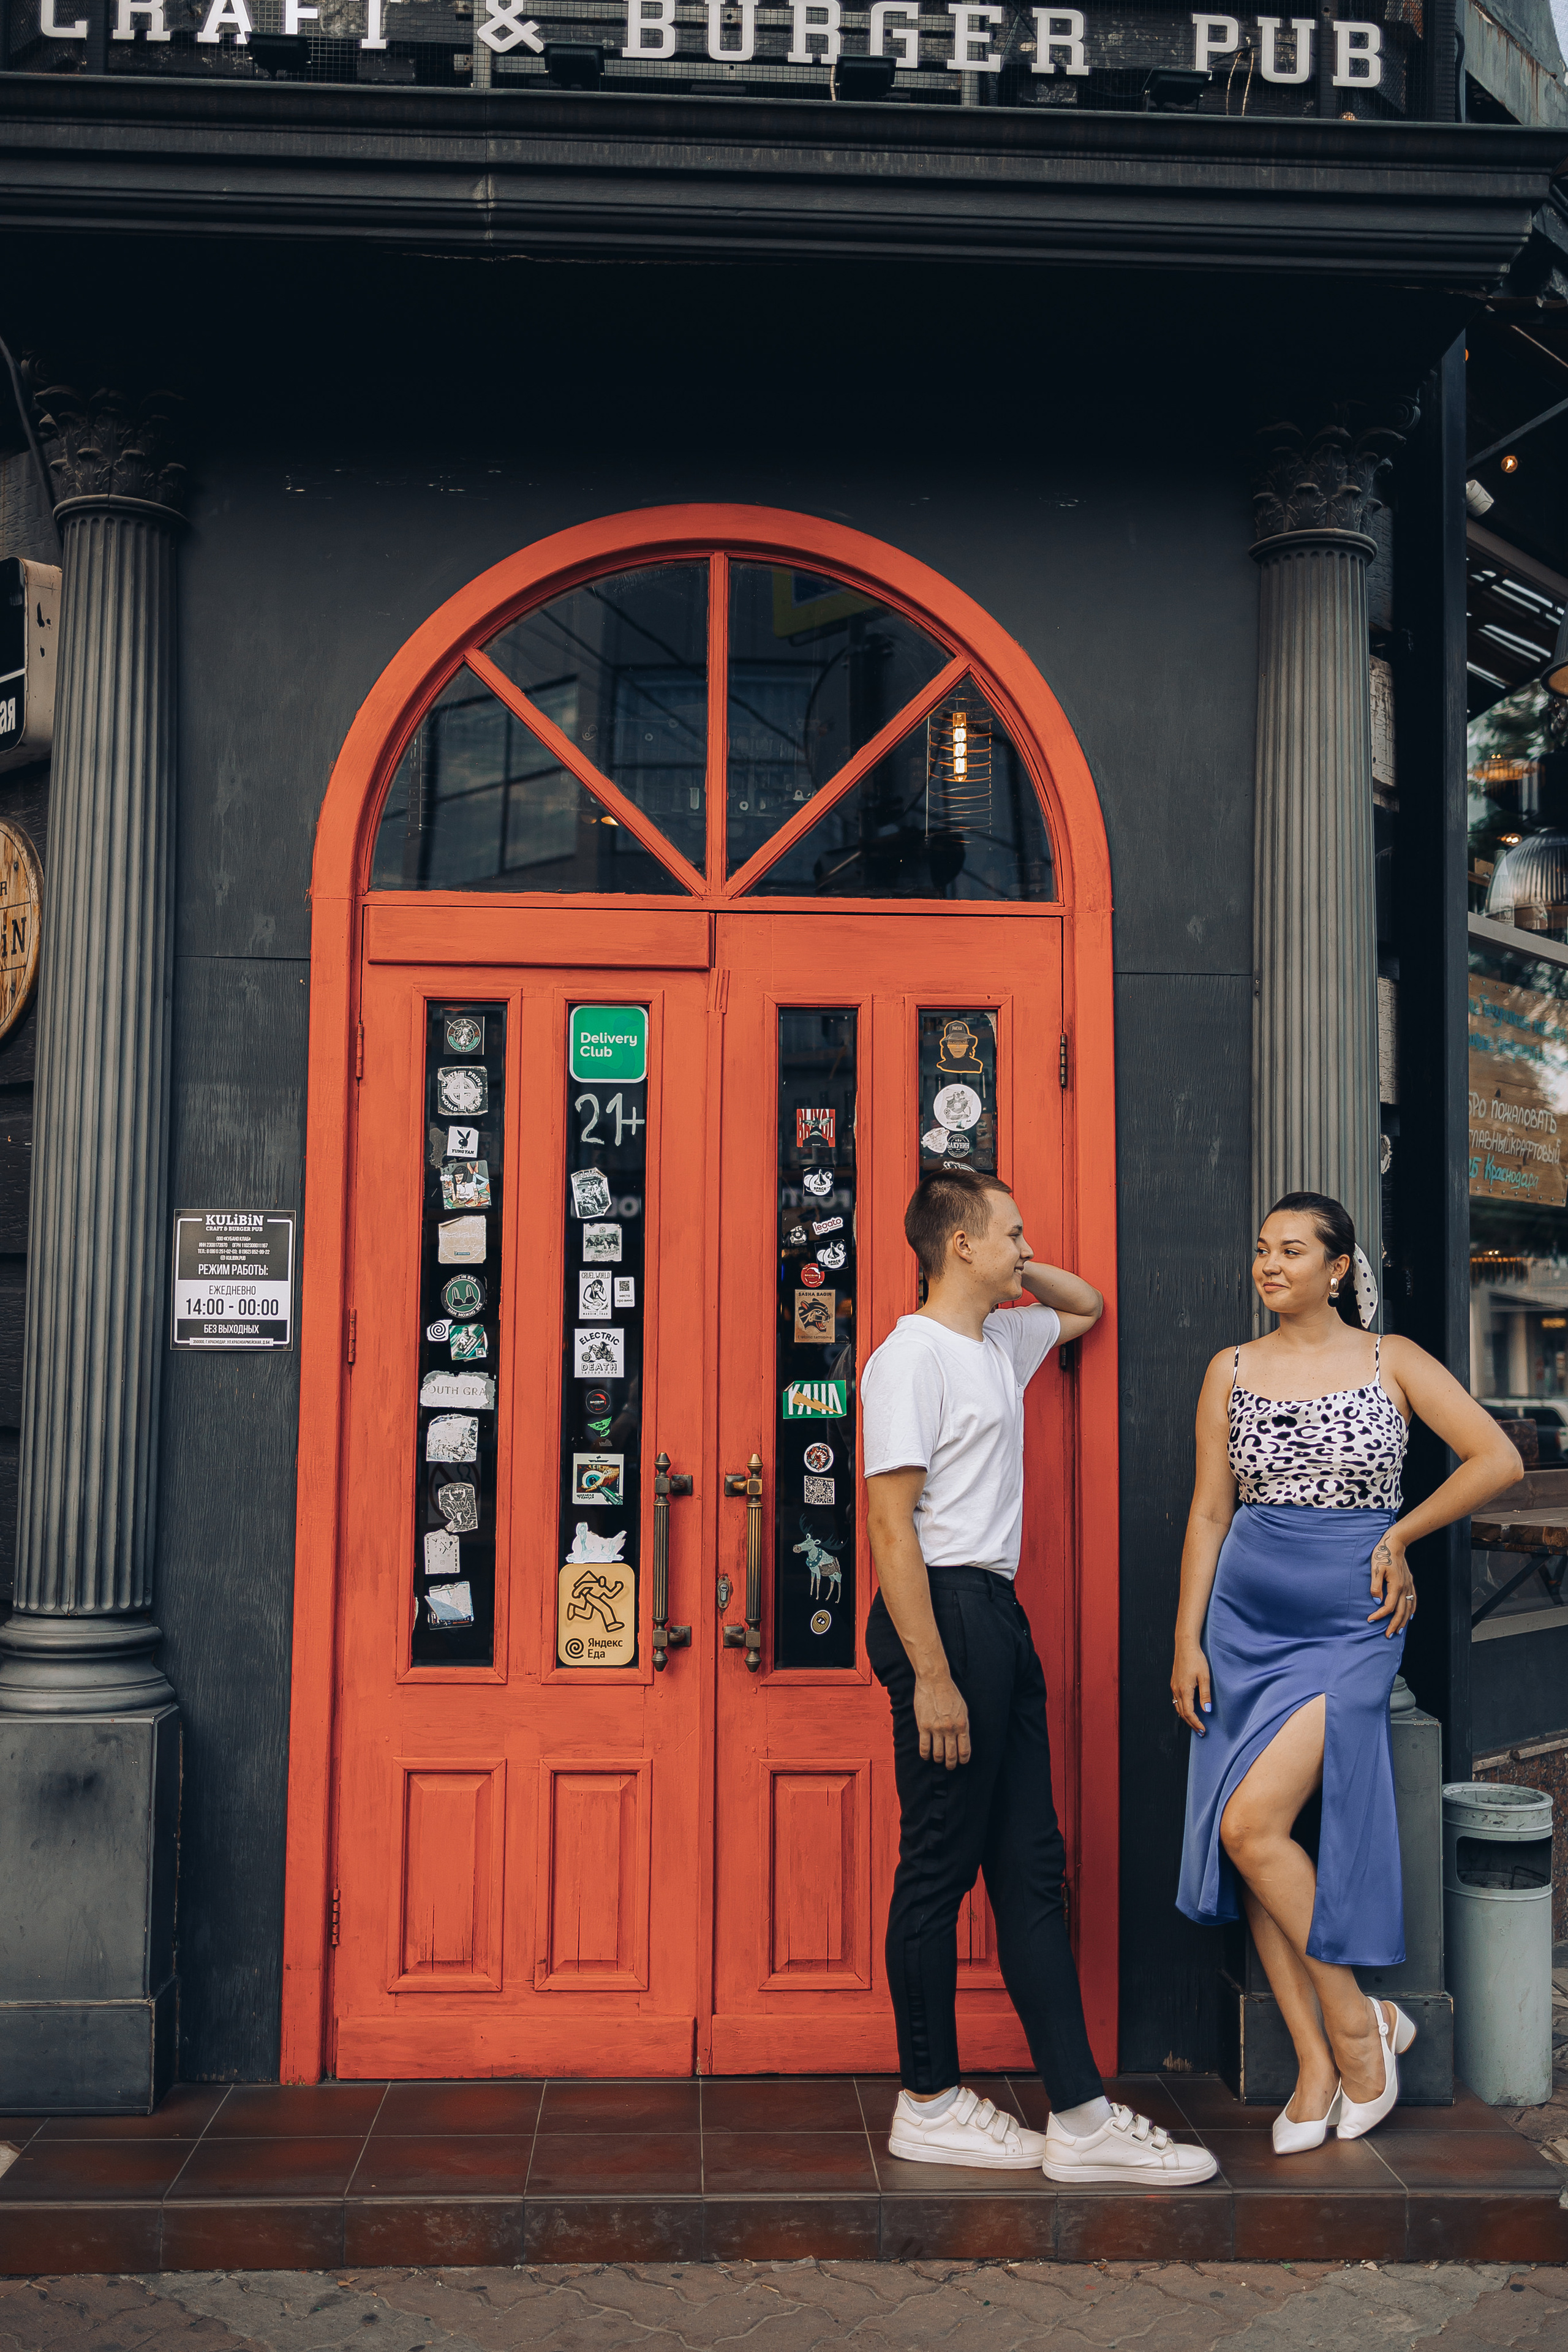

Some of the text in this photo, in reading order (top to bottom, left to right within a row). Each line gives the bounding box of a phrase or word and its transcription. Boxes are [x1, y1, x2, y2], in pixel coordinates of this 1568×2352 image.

[477, 0, 545, 53] &
[622, 0, 1090, 76] BURGER
[1191, 13, 1382, 88] PUB
[581, 1032, 638, 1046] Delivery
[580, 1046, 612, 1057] Club
[467, 1071, 483, 1087] PRIDE
[441, 1095, 458, 1111] WORLD
[575, 1093, 645, 1147] 21+
[1491, 1099, 1557, 1134] ПОЖАЛОВАТЬ
[814, 1218, 842, 1232] legato
[198, 1264, 269, 1276] РЕЖИМ РАБОТЫ:
[209, 1285, 256, 1295] ЕЖЕДНЕВНО
[186, 1298, 224, 1315] 14:00
[238, 1298, 279, 1316] 00:00
[447, 1308, 458, 1316] НАМ
[204, 1324, 259, 1335] БЕЗ ВЫХОДНЫХ
[579, 1332, 620, 1346] ELECTRIC
[581, 1363, 617, 1371] DEATH
[588, 1638, 624, 1649] Яндекс
[587, 1649, 606, 1659] Еда
